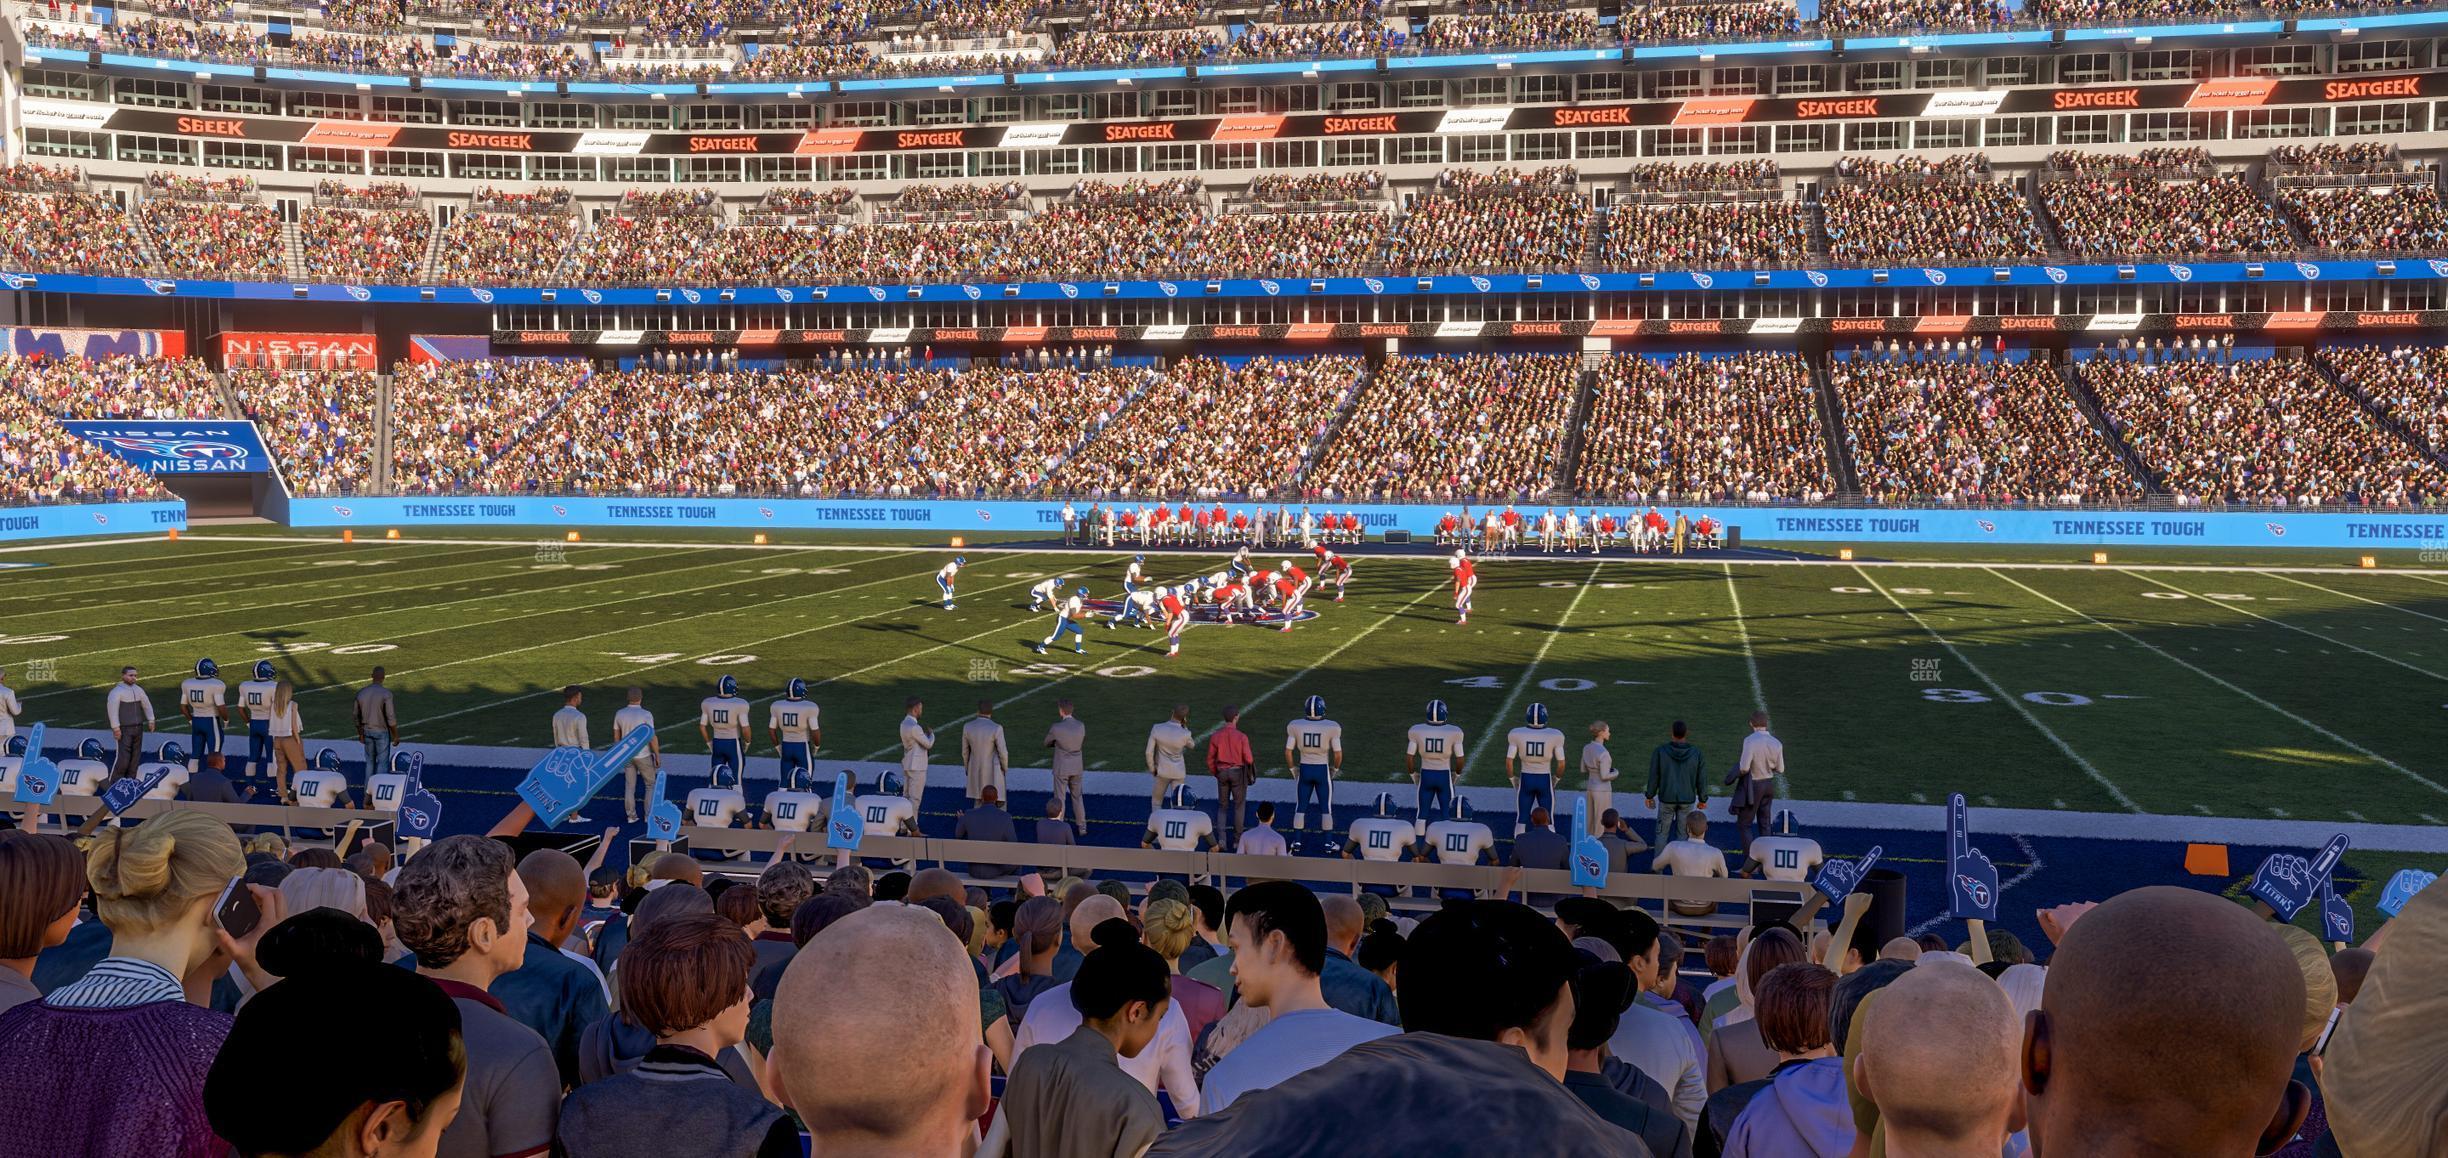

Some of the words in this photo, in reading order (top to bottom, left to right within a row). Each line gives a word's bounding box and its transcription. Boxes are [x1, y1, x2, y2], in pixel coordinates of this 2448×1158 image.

[2325, 76, 2420, 100] SEATGEEK
[2054, 88, 2139, 109] SEATGEEK
[1797, 98, 1878, 118] SEATGEEK
[1554, 107, 1631, 126] SEATGEEK
[1105, 123, 1175, 141] SEATGEEK
[1324, 115, 1397, 134] SEATGEEK
[448, 131, 532, 150] SEATGEEK
[689, 136, 758, 152] SEATGEEK
[898, 130, 964, 148] SEATGEEK
[1669, 321, 1722, 334] SEATGEEK
[1832, 319, 1885, 332] SEATGEEK
[2001, 317, 2056, 330] SEATGEEK
[2176, 315, 2234, 329] SEATGEEK
[2357, 313, 2420, 327] SEATGEEK
[802, 331, 845, 343] SEATGEEK
[936, 330, 979, 342] SEATGEEK
[1072, 328, 1118, 340] SEATGEEK
[1213, 326, 1260, 338] SEATGEEK
[1361, 325, 1409, 337] SEATGEEK
[1512, 323, 1563, 336] SEATGEEK
[521, 332, 570, 343] SEATGEEK
[669, 332, 714, 344] SEATGEEK
[152, 459, 246, 471] NISSAN
[403, 505, 475, 517] TENNESSEE
[479, 505, 515, 517] TOUGH
[607, 505, 673, 518] TENNESSEE
[677, 506, 716, 519] TOUGH
[816, 508, 886, 521] TENNESSEE
[890, 508, 931, 521] TOUGH
[1777, 518, 1863, 532] TENNESSEE
[1869, 519, 1919, 533] TOUGH
[2053, 521, 2144, 535] TENNESSEE
[2151, 522, 2204, 536] TOUGH
[2346, 523, 2445, 538] TENNESSEE
[1443, 675, 1597, 691] 40
[190, 690, 204, 704] 00
[248, 692, 262, 705] 00
[1921, 688, 2094, 706] 30
[713, 709, 728, 723] 00
[782, 712, 798, 727] 00
[1303, 733, 1321, 748] 00
[1425, 738, 1443, 754] 00
[1526, 741, 1544, 757] 00
[62, 769, 80, 785] 00
[301, 781, 318, 796] 00
[377, 784, 395, 800] 00
[700, 799, 719, 816] 00
[777, 802, 797, 819] 00
[866, 806, 887, 824] 00
[1164, 820, 1187, 839] 00
[1369, 830, 1391, 849] 00
[1446, 833, 1469, 852] 00
[1774, 849, 1798, 869] 00
[2262, 879, 2295, 912] TITANS
